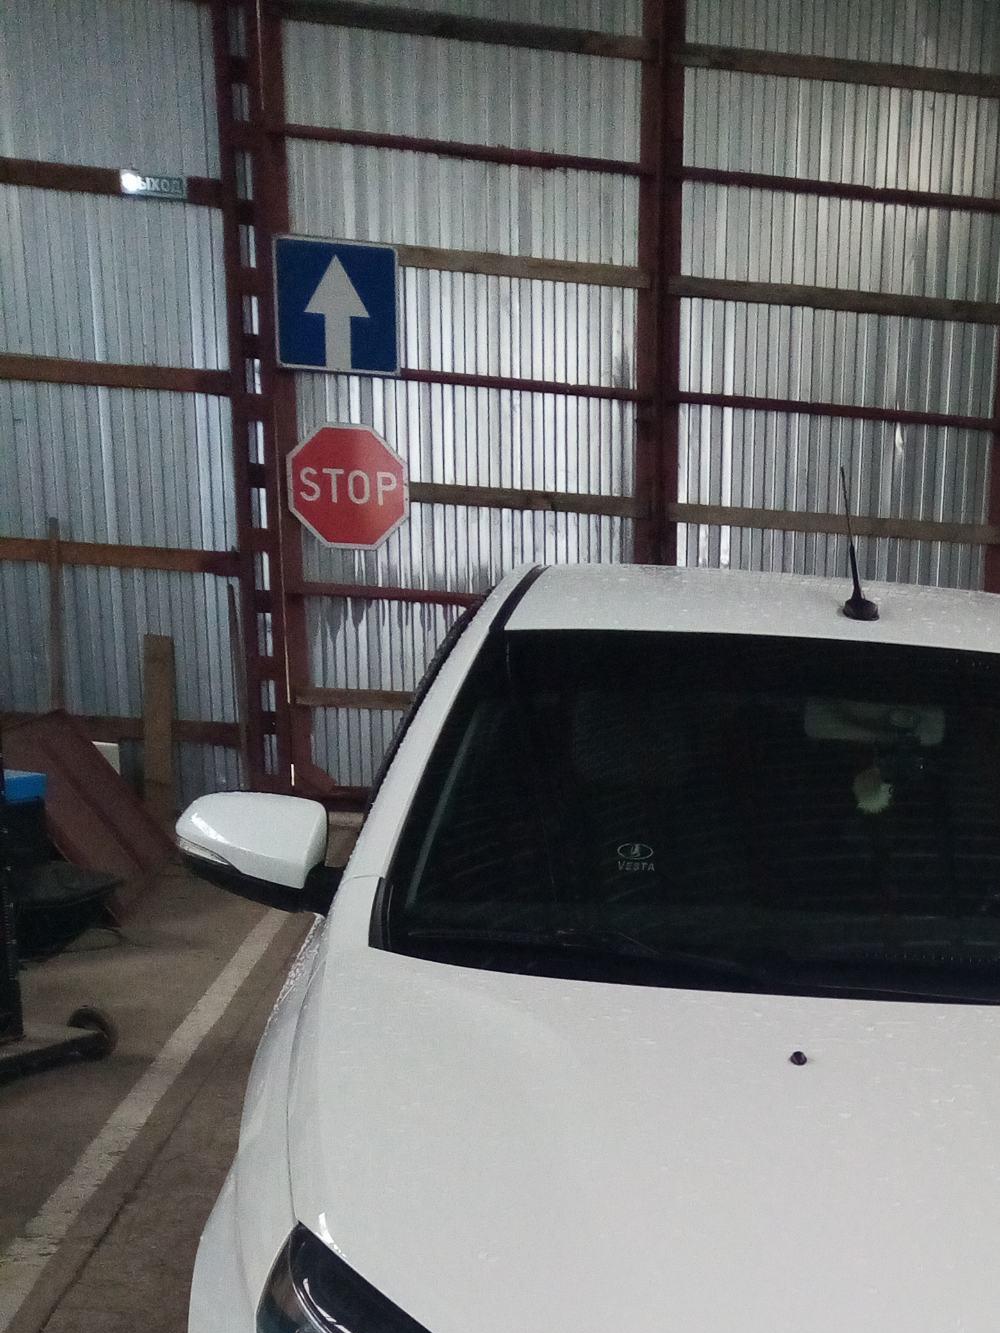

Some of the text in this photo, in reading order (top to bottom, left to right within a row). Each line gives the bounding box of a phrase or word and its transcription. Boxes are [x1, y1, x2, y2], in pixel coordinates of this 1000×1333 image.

[127, 175, 181, 193] ЫХОД
[300, 467, 397, 505] STOP
[617, 861, 655, 871] VESTA
